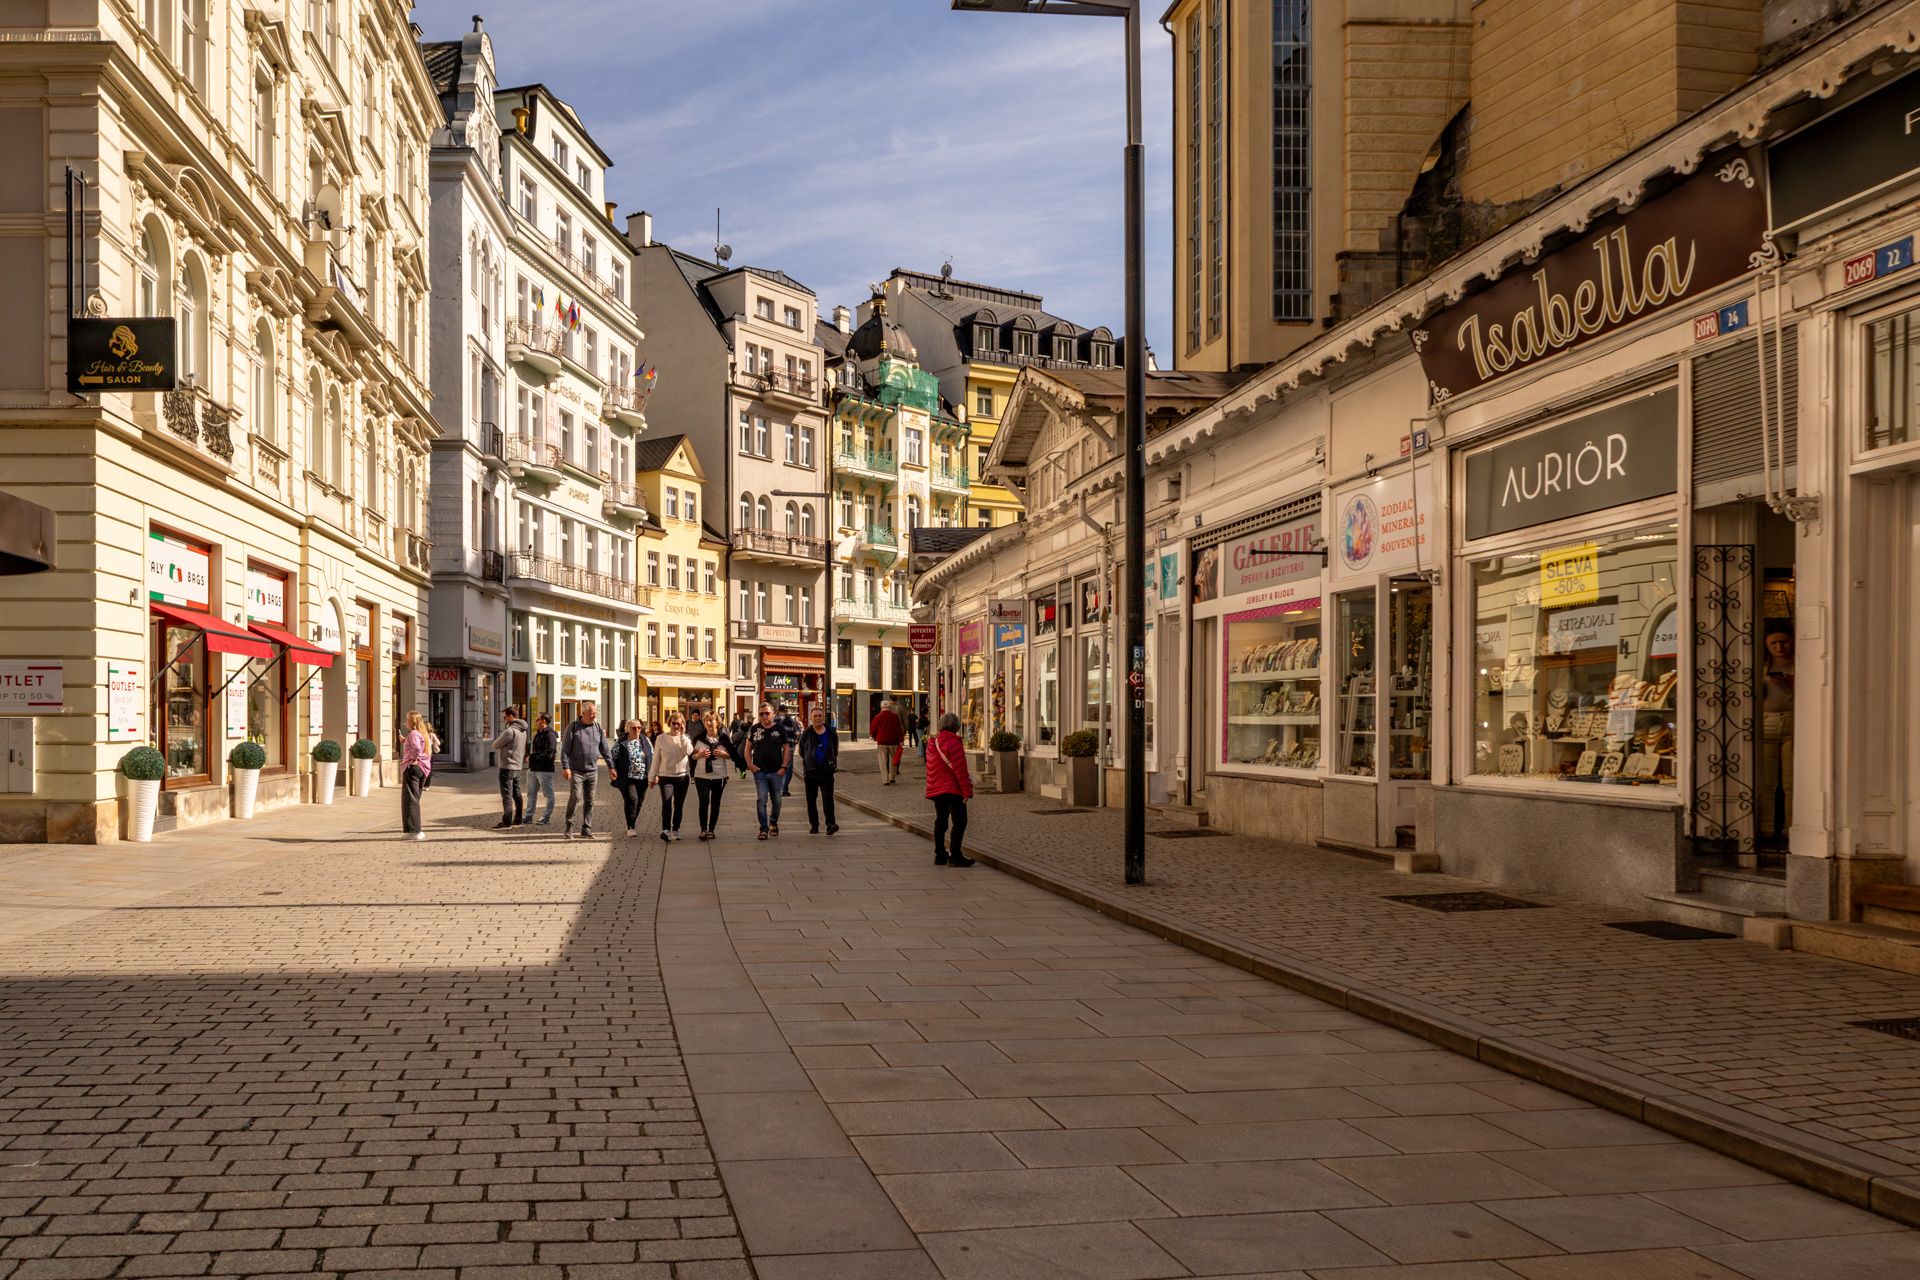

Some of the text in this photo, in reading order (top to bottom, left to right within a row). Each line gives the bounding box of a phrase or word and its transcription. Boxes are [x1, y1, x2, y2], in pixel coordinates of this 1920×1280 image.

[1887, 249, 1900, 267] 22
[1846, 258, 1873, 283] 2069
[1457, 225, 1696, 380] Isabella
[1695, 318, 1716, 338] 2070
[1727, 311, 1739, 327] 24
[86, 360, 164, 376] Hair & Beauty
[106, 375, 141, 384] SALON
[1381, 499, 1415, 517] ZODIAC
[1381, 513, 1425, 535] MINERAS
[1233, 524, 1315, 571] GALERIE
[1546, 555, 1593, 579] SLEVA
[187, 571, 205, 586] BAGS
[1554, 577, 1585, 595] -50%
[267, 593, 282, 607] BAGS
[1246, 593, 1268, 605] JEWELRY
[1274, 588, 1294, 600] BIJOUX
[0, 675, 45, 686] TLET
[111, 681, 136, 691] OUTLET
